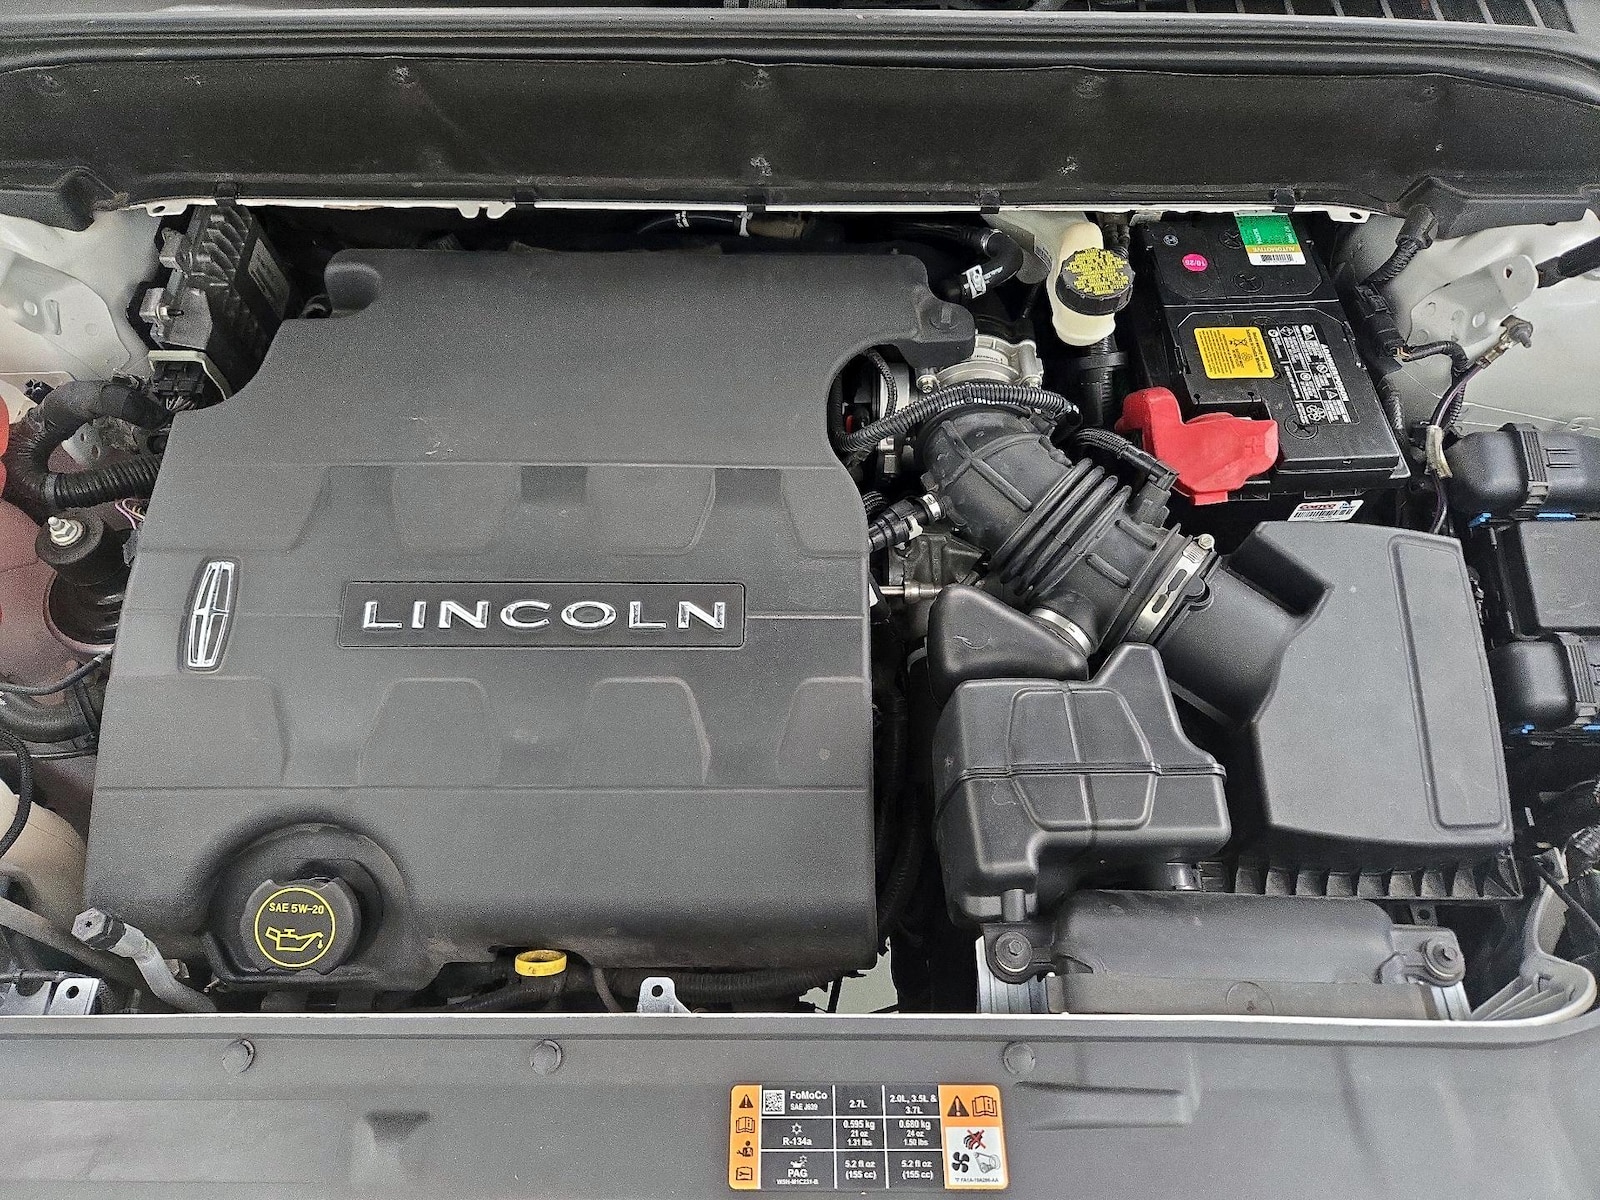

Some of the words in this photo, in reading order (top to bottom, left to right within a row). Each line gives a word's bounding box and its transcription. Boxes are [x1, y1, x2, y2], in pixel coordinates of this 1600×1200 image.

[363, 600, 726, 629] LINCOLN
[268, 902, 289, 913] SAE
[291, 903, 325, 915] 5W-20
[790, 1091, 828, 1100] FoMoCo
[889, 1095, 910, 1104] 2.0L,
[911, 1095, 930, 1103] 3.5L
[930, 1094, 938, 1103] &
[790, 1103, 803, 1111] SAE
[849, 1099, 868, 1108] 2.7L
[905, 1106, 924, 1114] 3.7L
[843, 1120, 865, 1128] 0.595
[865, 1120, 876, 1131] kg
[898, 1120, 920, 1128] 0.680
[921, 1120, 931, 1131] kg
[782, 1137, 813, 1146] R-134a
[845, 1160, 857, 1168] 5.2
[901, 1160, 914, 1168] 5.2
[787, 1169, 808, 1178] PAG
[845, 1171, 863, 1180] (155
[864, 1171, 877, 1180] cc)
[902, 1171, 920, 1180] (155
[921, 1171, 934, 1180] cc)
